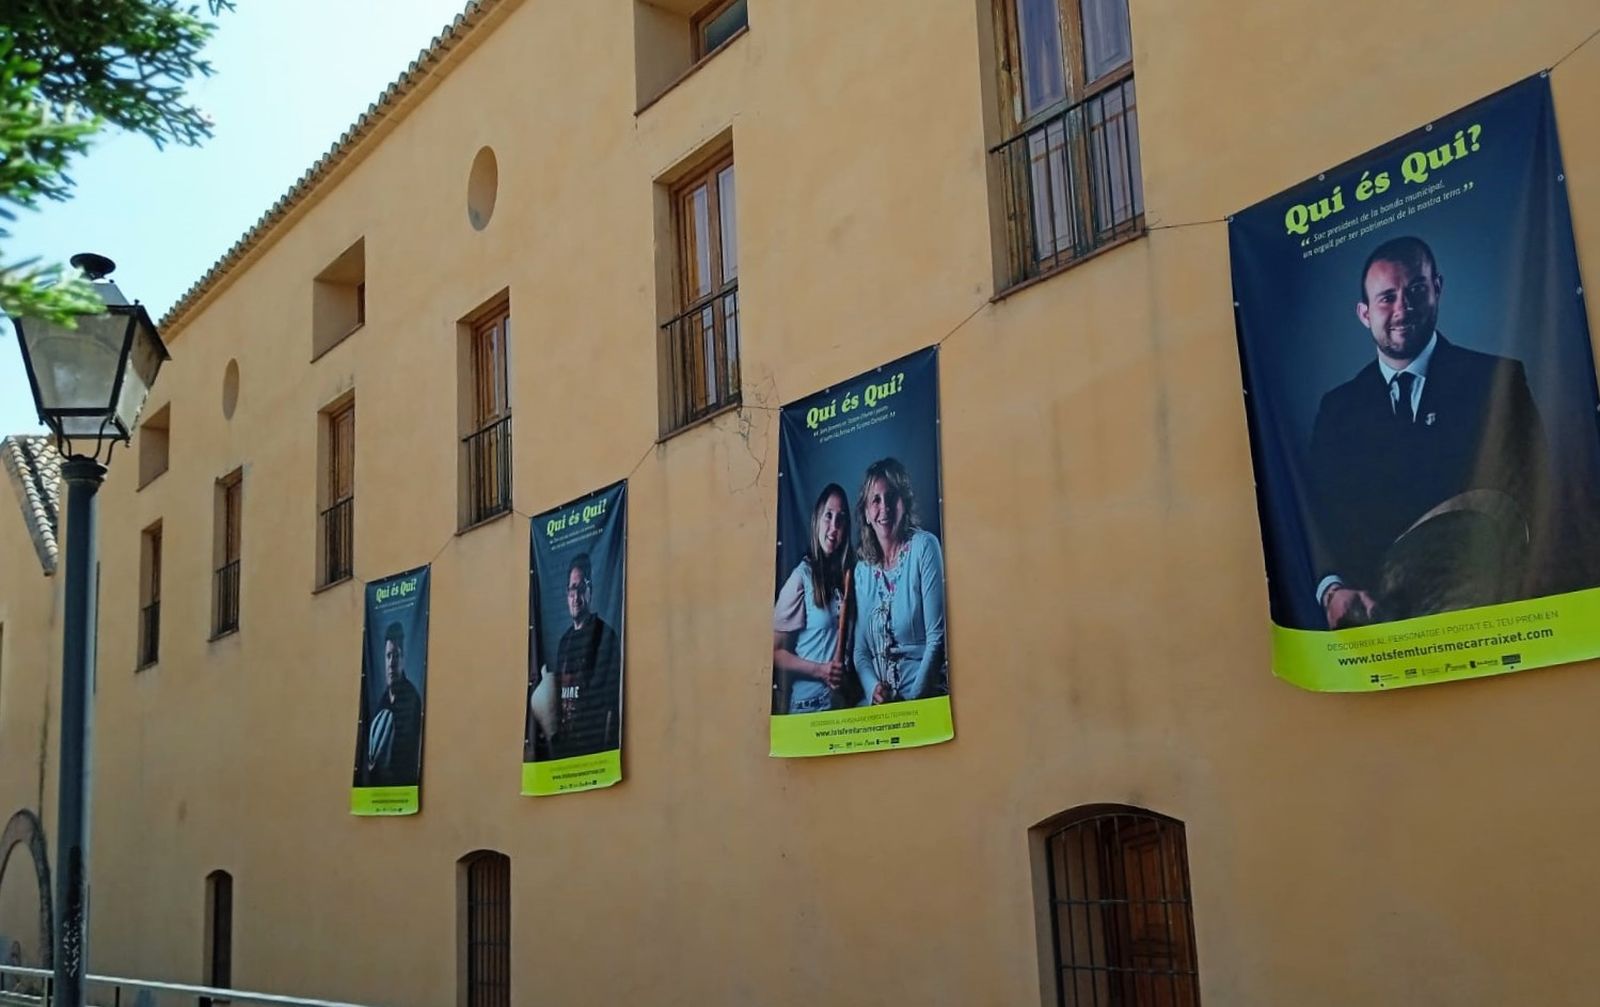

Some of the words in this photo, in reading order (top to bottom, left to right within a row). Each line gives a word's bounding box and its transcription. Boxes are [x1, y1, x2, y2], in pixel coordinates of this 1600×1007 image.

[1285, 186, 1345, 235] Qui
[1355, 171, 1390, 201] és
[1401, 124, 1481, 184] Qui?
[1335, 236, 1347, 248] per
[1360, 213, 1395, 237] patrimoni
[1396, 210, 1406, 220] de
[1407, 206, 1416, 216] la
[1360, 212, 1369, 222] de
[1370, 208, 1379, 218] la
[1379, 198, 1404, 214] banda
[806, 399, 837, 429] Qui
[841, 392, 859, 413] és
[864, 373, 904, 407] Qui?
[547, 514, 566, 537] Qui
[569, 509, 580, 526] és
[582, 498, 607, 524] Qui?
[376, 586, 390, 603] Qui
[400, 578, 417, 597] Qui?
[1483, 620, 1494, 629] EL
[1338, 628, 1554, 666] www.totsfemturismecarraixet.com
